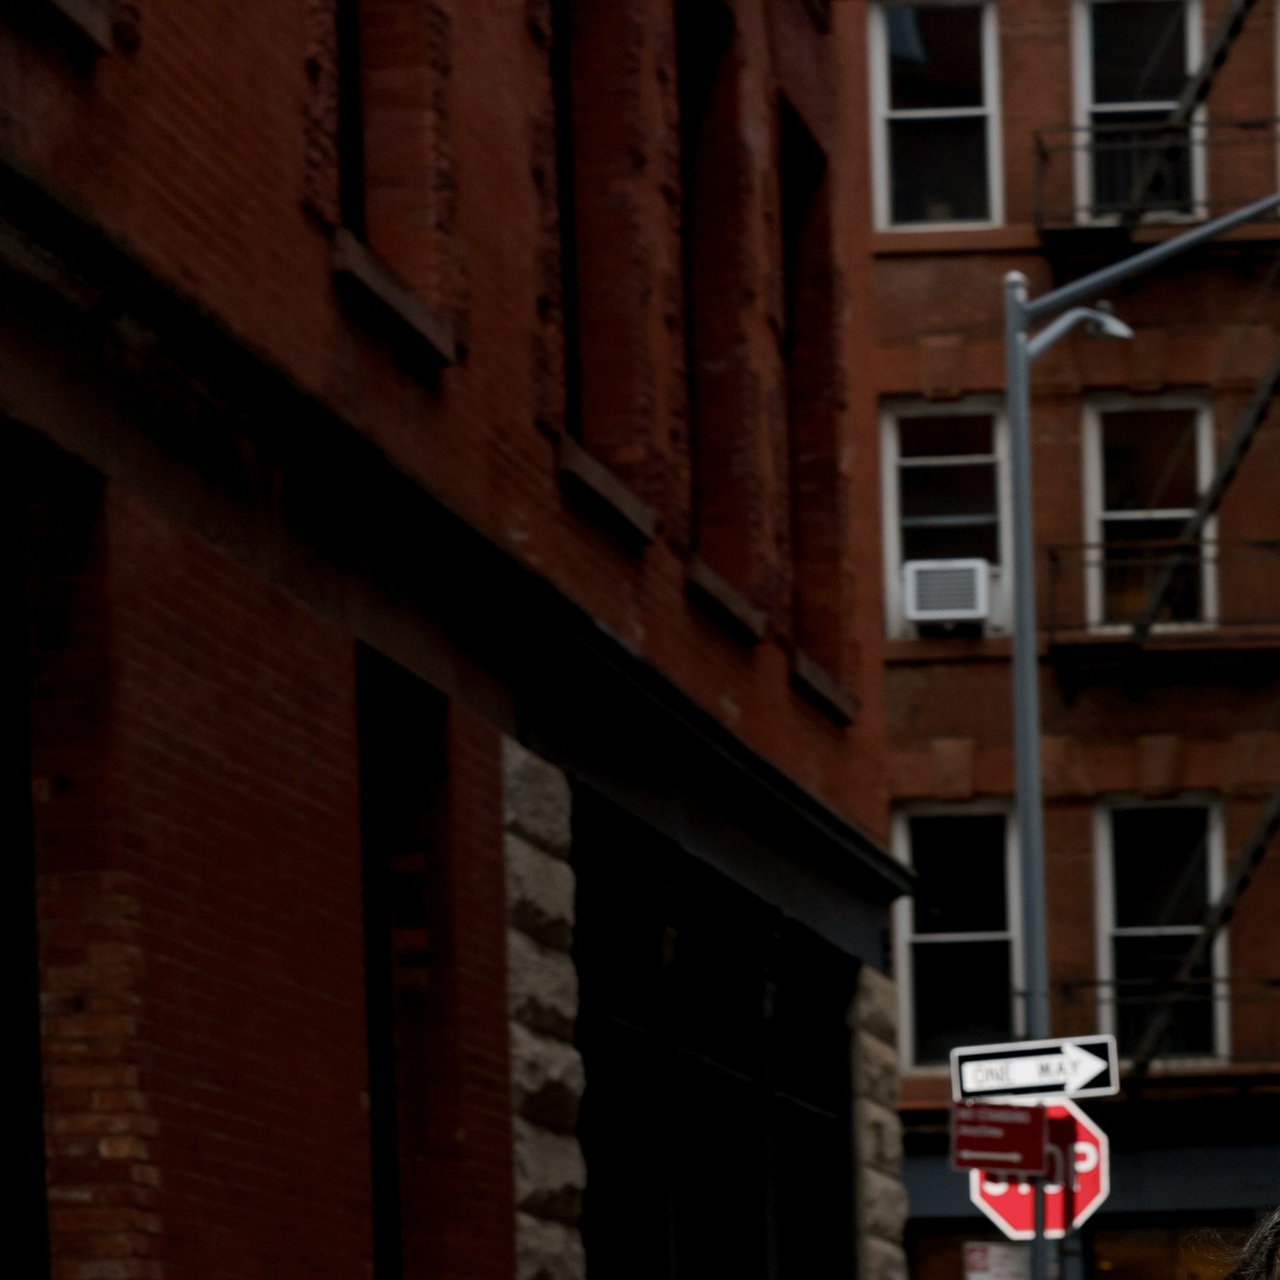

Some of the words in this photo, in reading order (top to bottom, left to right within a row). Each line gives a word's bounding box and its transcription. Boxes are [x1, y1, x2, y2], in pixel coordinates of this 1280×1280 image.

[975, 1064, 1010, 1084] ONE
[1039, 1060, 1081, 1078] WAY
[981, 1141, 1099, 1196] OP
